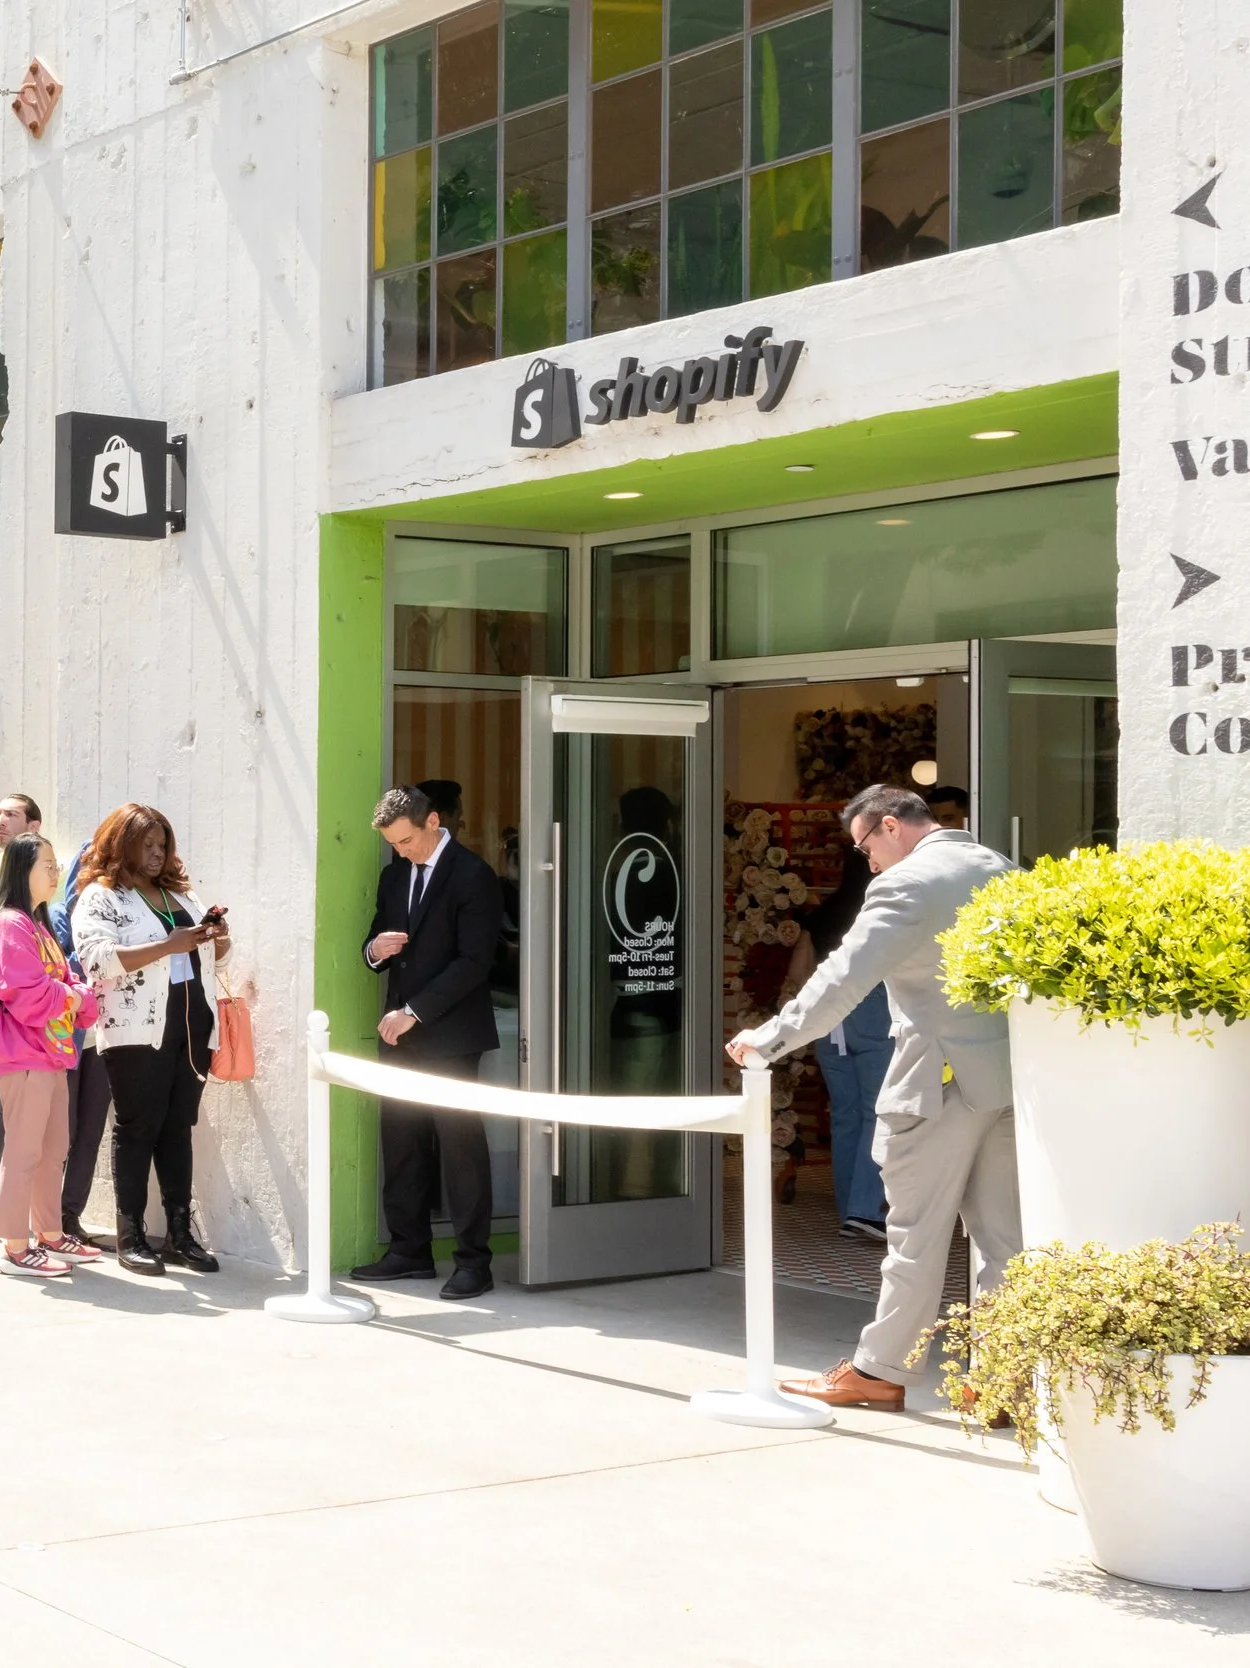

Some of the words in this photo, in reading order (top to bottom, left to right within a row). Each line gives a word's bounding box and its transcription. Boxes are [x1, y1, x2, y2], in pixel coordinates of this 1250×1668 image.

[584, 326, 805, 425] shopify
[1170, 335, 1250, 384] St
[520, 388, 544, 440] S
[101, 462, 120, 503] S
[1169, 711, 1250, 755] Co
